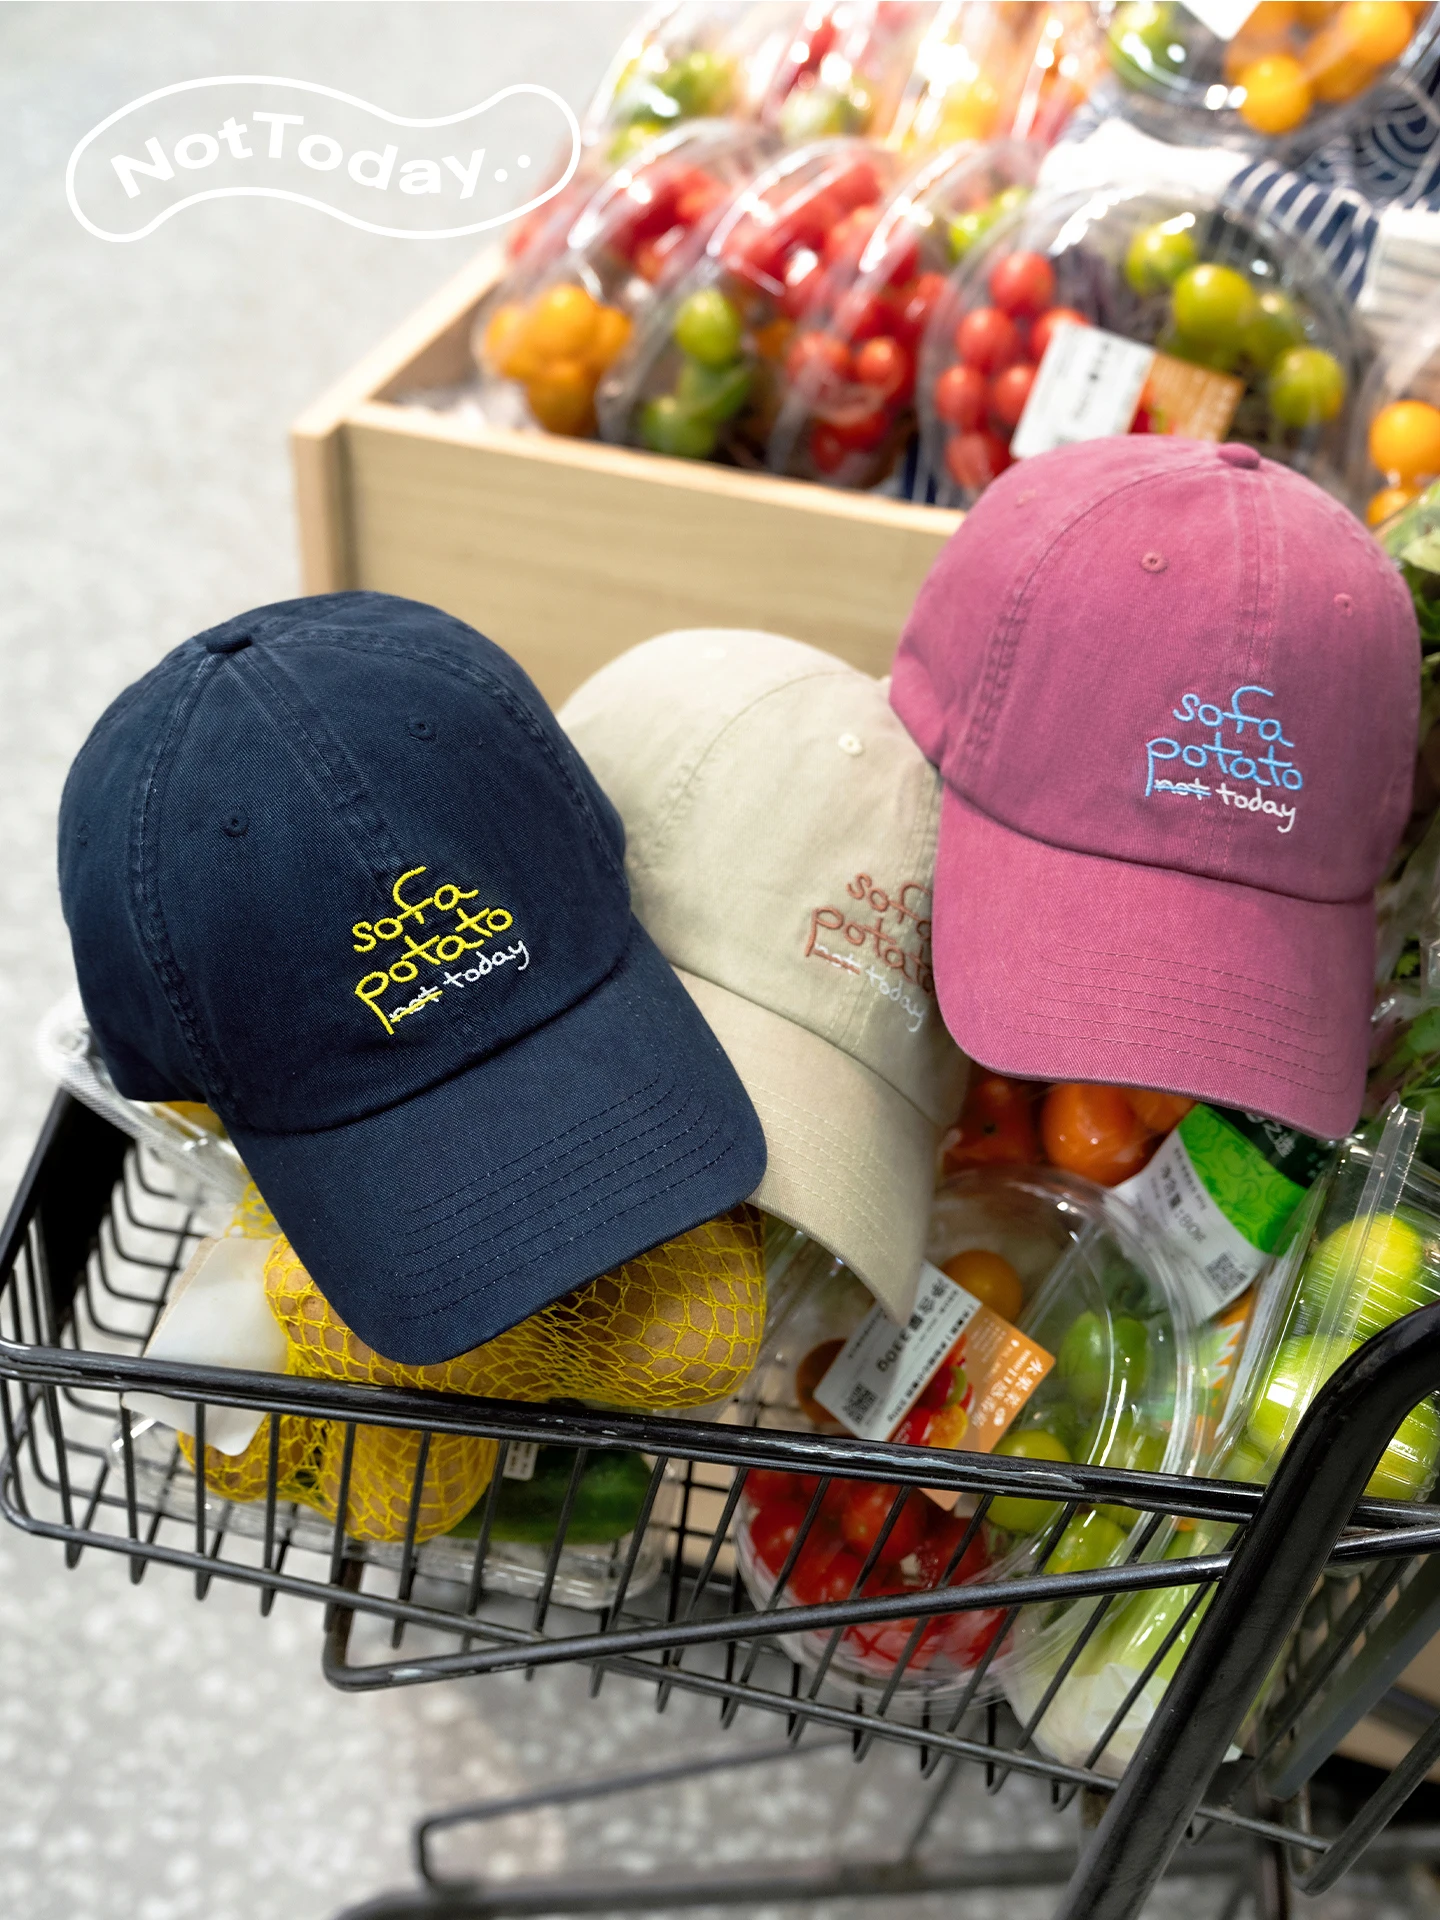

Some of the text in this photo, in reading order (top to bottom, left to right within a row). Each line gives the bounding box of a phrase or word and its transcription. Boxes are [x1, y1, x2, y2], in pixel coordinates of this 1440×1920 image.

[1172, 685, 1295, 748] sofa
[1145, 732, 1304, 797] potato
[1215, 783, 1296, 834] today
[352, 866, 479, 953] sofa
[355, 908, 513, 1035] potato
[443, 940, 530, 988] today
[865, 965, 925, 1033] today
